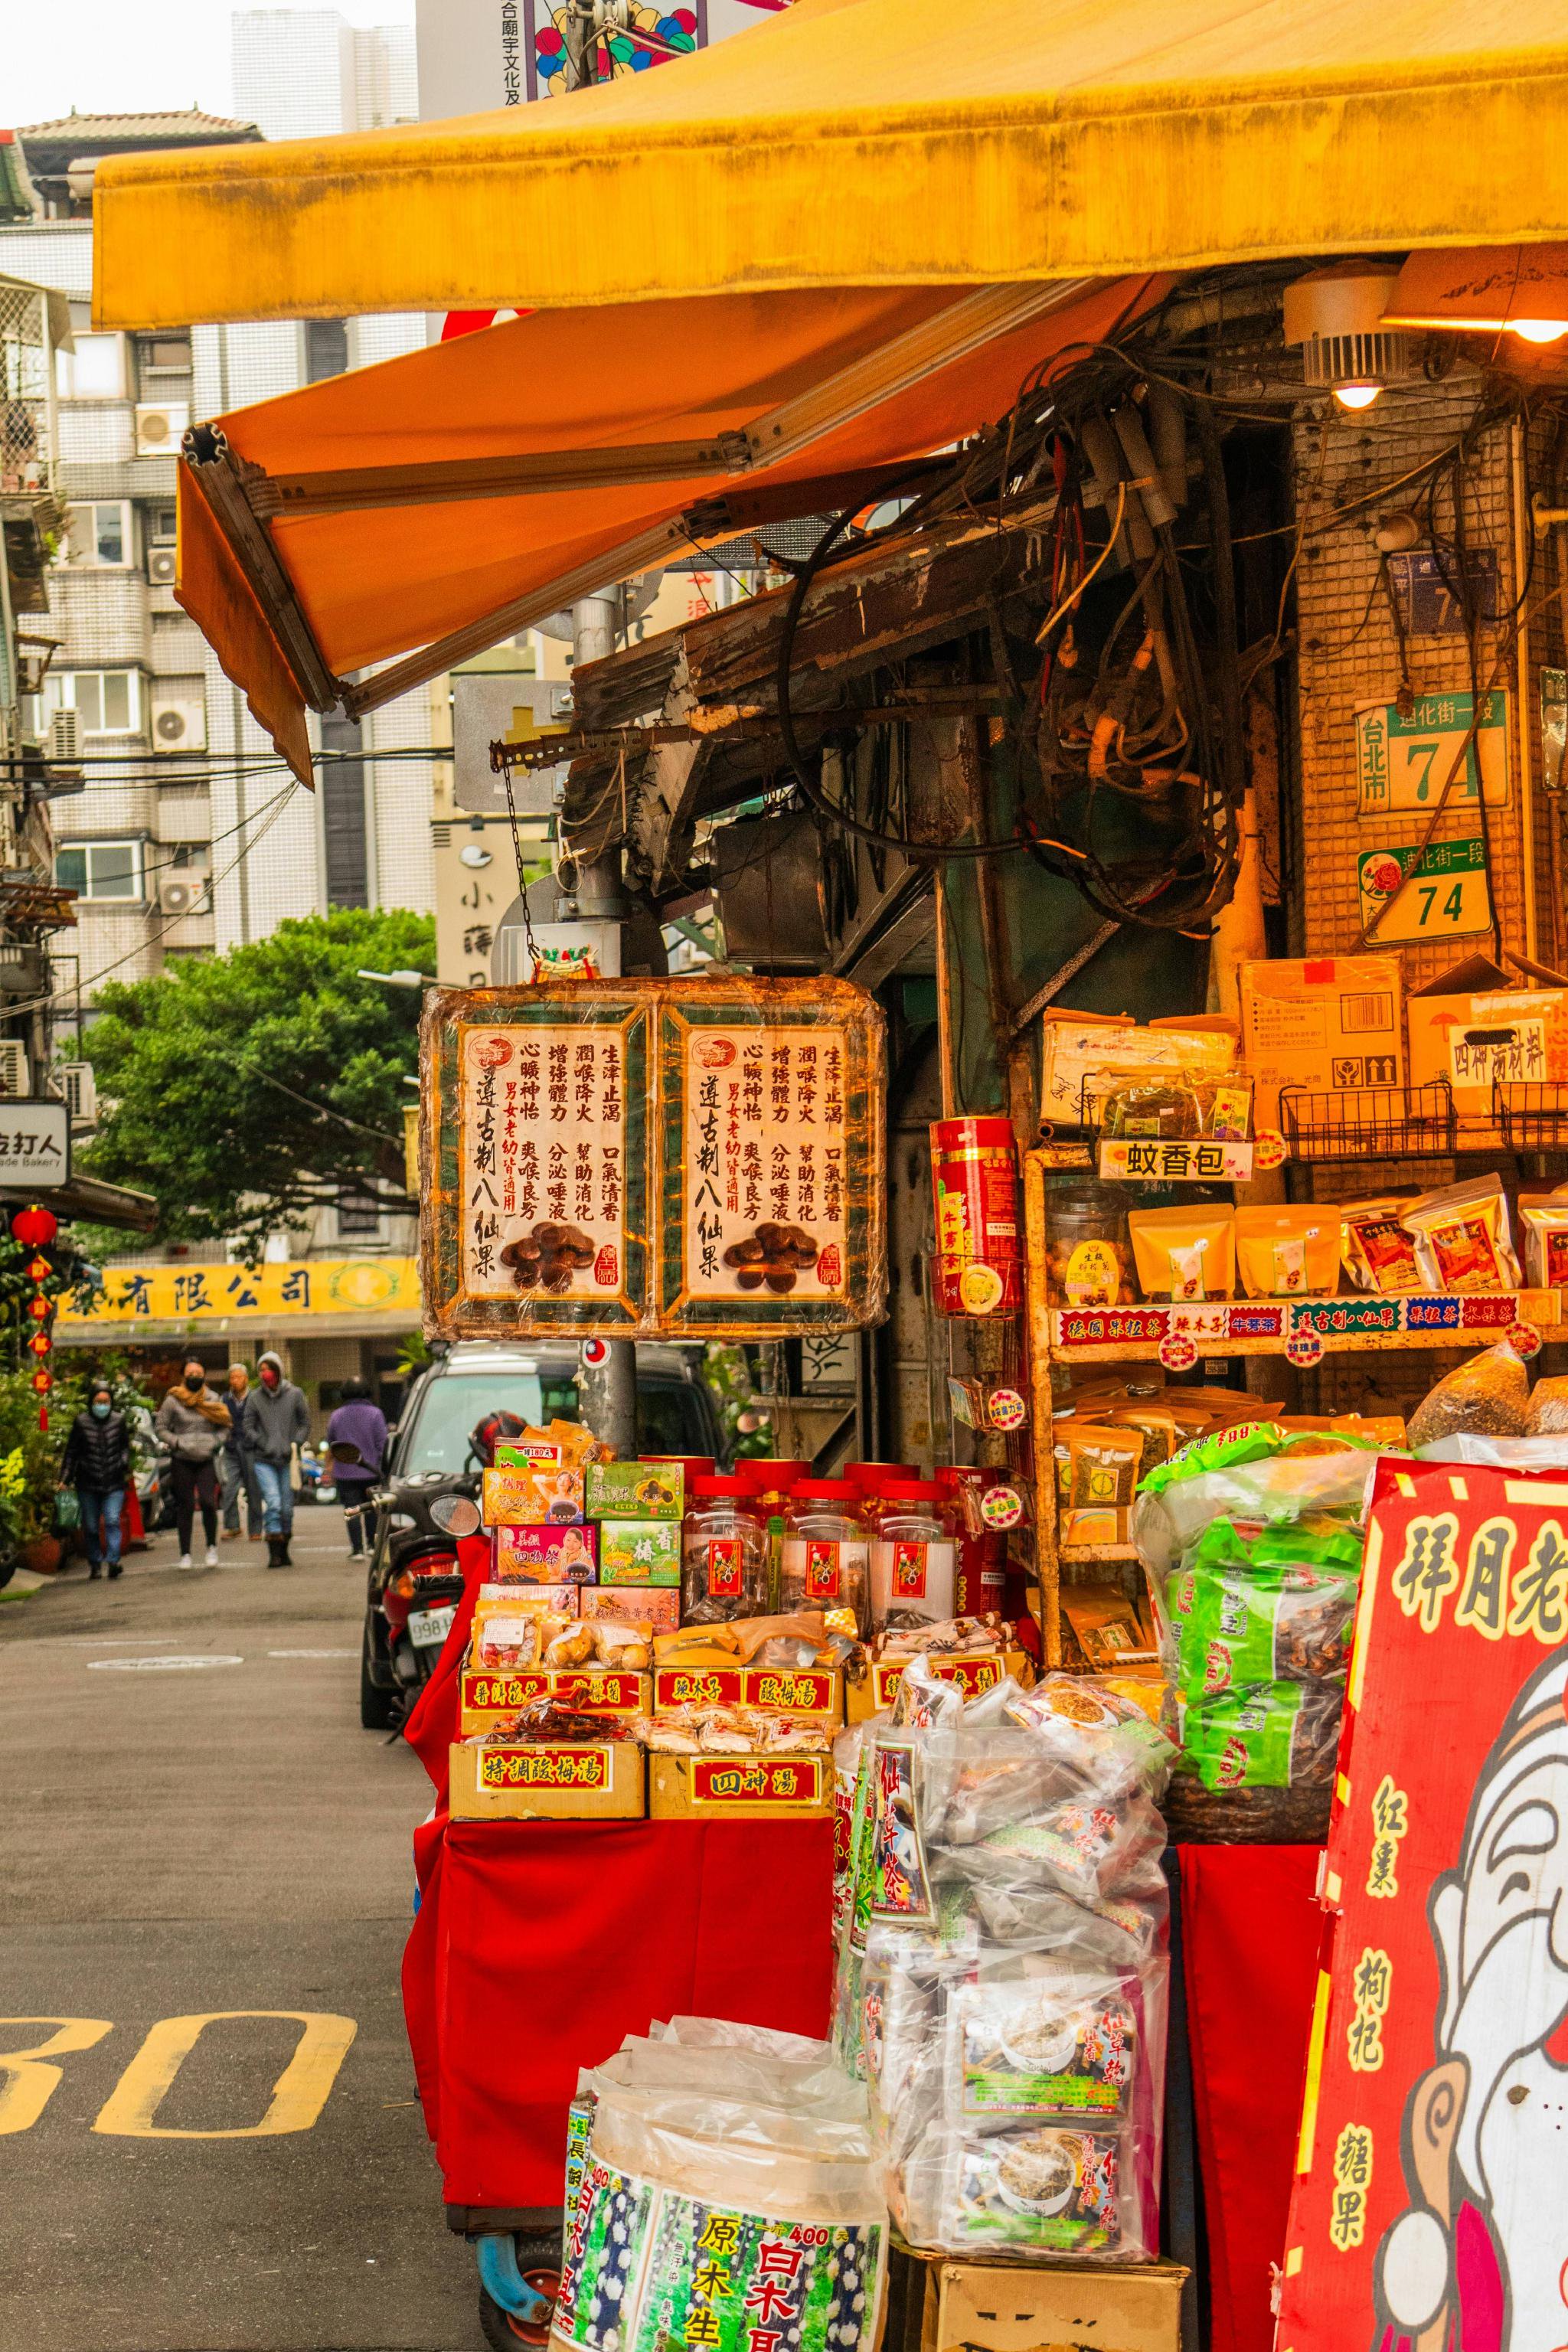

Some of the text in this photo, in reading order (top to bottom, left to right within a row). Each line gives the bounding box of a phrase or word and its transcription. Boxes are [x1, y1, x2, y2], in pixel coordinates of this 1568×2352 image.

[1363, 718, 1387, 800] 台北市
[1418, 882, 1463, 926] 74
[502, 1082, 518, 1213] 男女老幼皆適用
[518, 1044, 540, 1220] 心曠神怡 爽喉良方
[547, 1044, 569, 1221] 增強體力 分泌唾液
[574, 1044, 595, 1221] 潤喉降火 幫助消化
[600, 1045, 622, 1222] 生津止渴 口氣清香
[725, 1083, 741, 1213] 男女老幼皆適用
[741, 1045, 763, 1221] 心曠神怡 爽喉良方
[769, 1046, 791, 1222] 增強體力 分泌唾液
[796, 1046, 818, 1222] 潤喉降火 幫助消化
[823, 1046, 845, 1222] 生津止渴 口氣清香
[1126, 1143, 1225, 1177] 蚊香包
[1068, 1319, 1163, 1339] 德國果粒茶
[1174, 1316, 1223, 1333] 辣木子
[1231, 1317, 1277, 1332] 牛蒡茶
[1409, 1305, 1459, 1325] 果粒茶
[1464, 1305, 1514, 1324] 水果茶
[513, 1549, 560, 1566] 四物茶
[674, 1677, 721, 1700] 辣木子
[760, 1679, 816, 1706] 酸梅湯
[483, 1756, 600, 1782] 特調酸梅湯
[710, 1770, 798, 1795] 四神湯
[880, 1751, 905, 1903] 仙草茶
[1352, 1956, 1387, 2066] 枸杞
[789, 2226, 829, 2246] 400
[835, 2230, 849, 2243] 元
[1334, 2132, 1369, 2244] 糖果
[684, 2213, 743, 2347] 原木生
